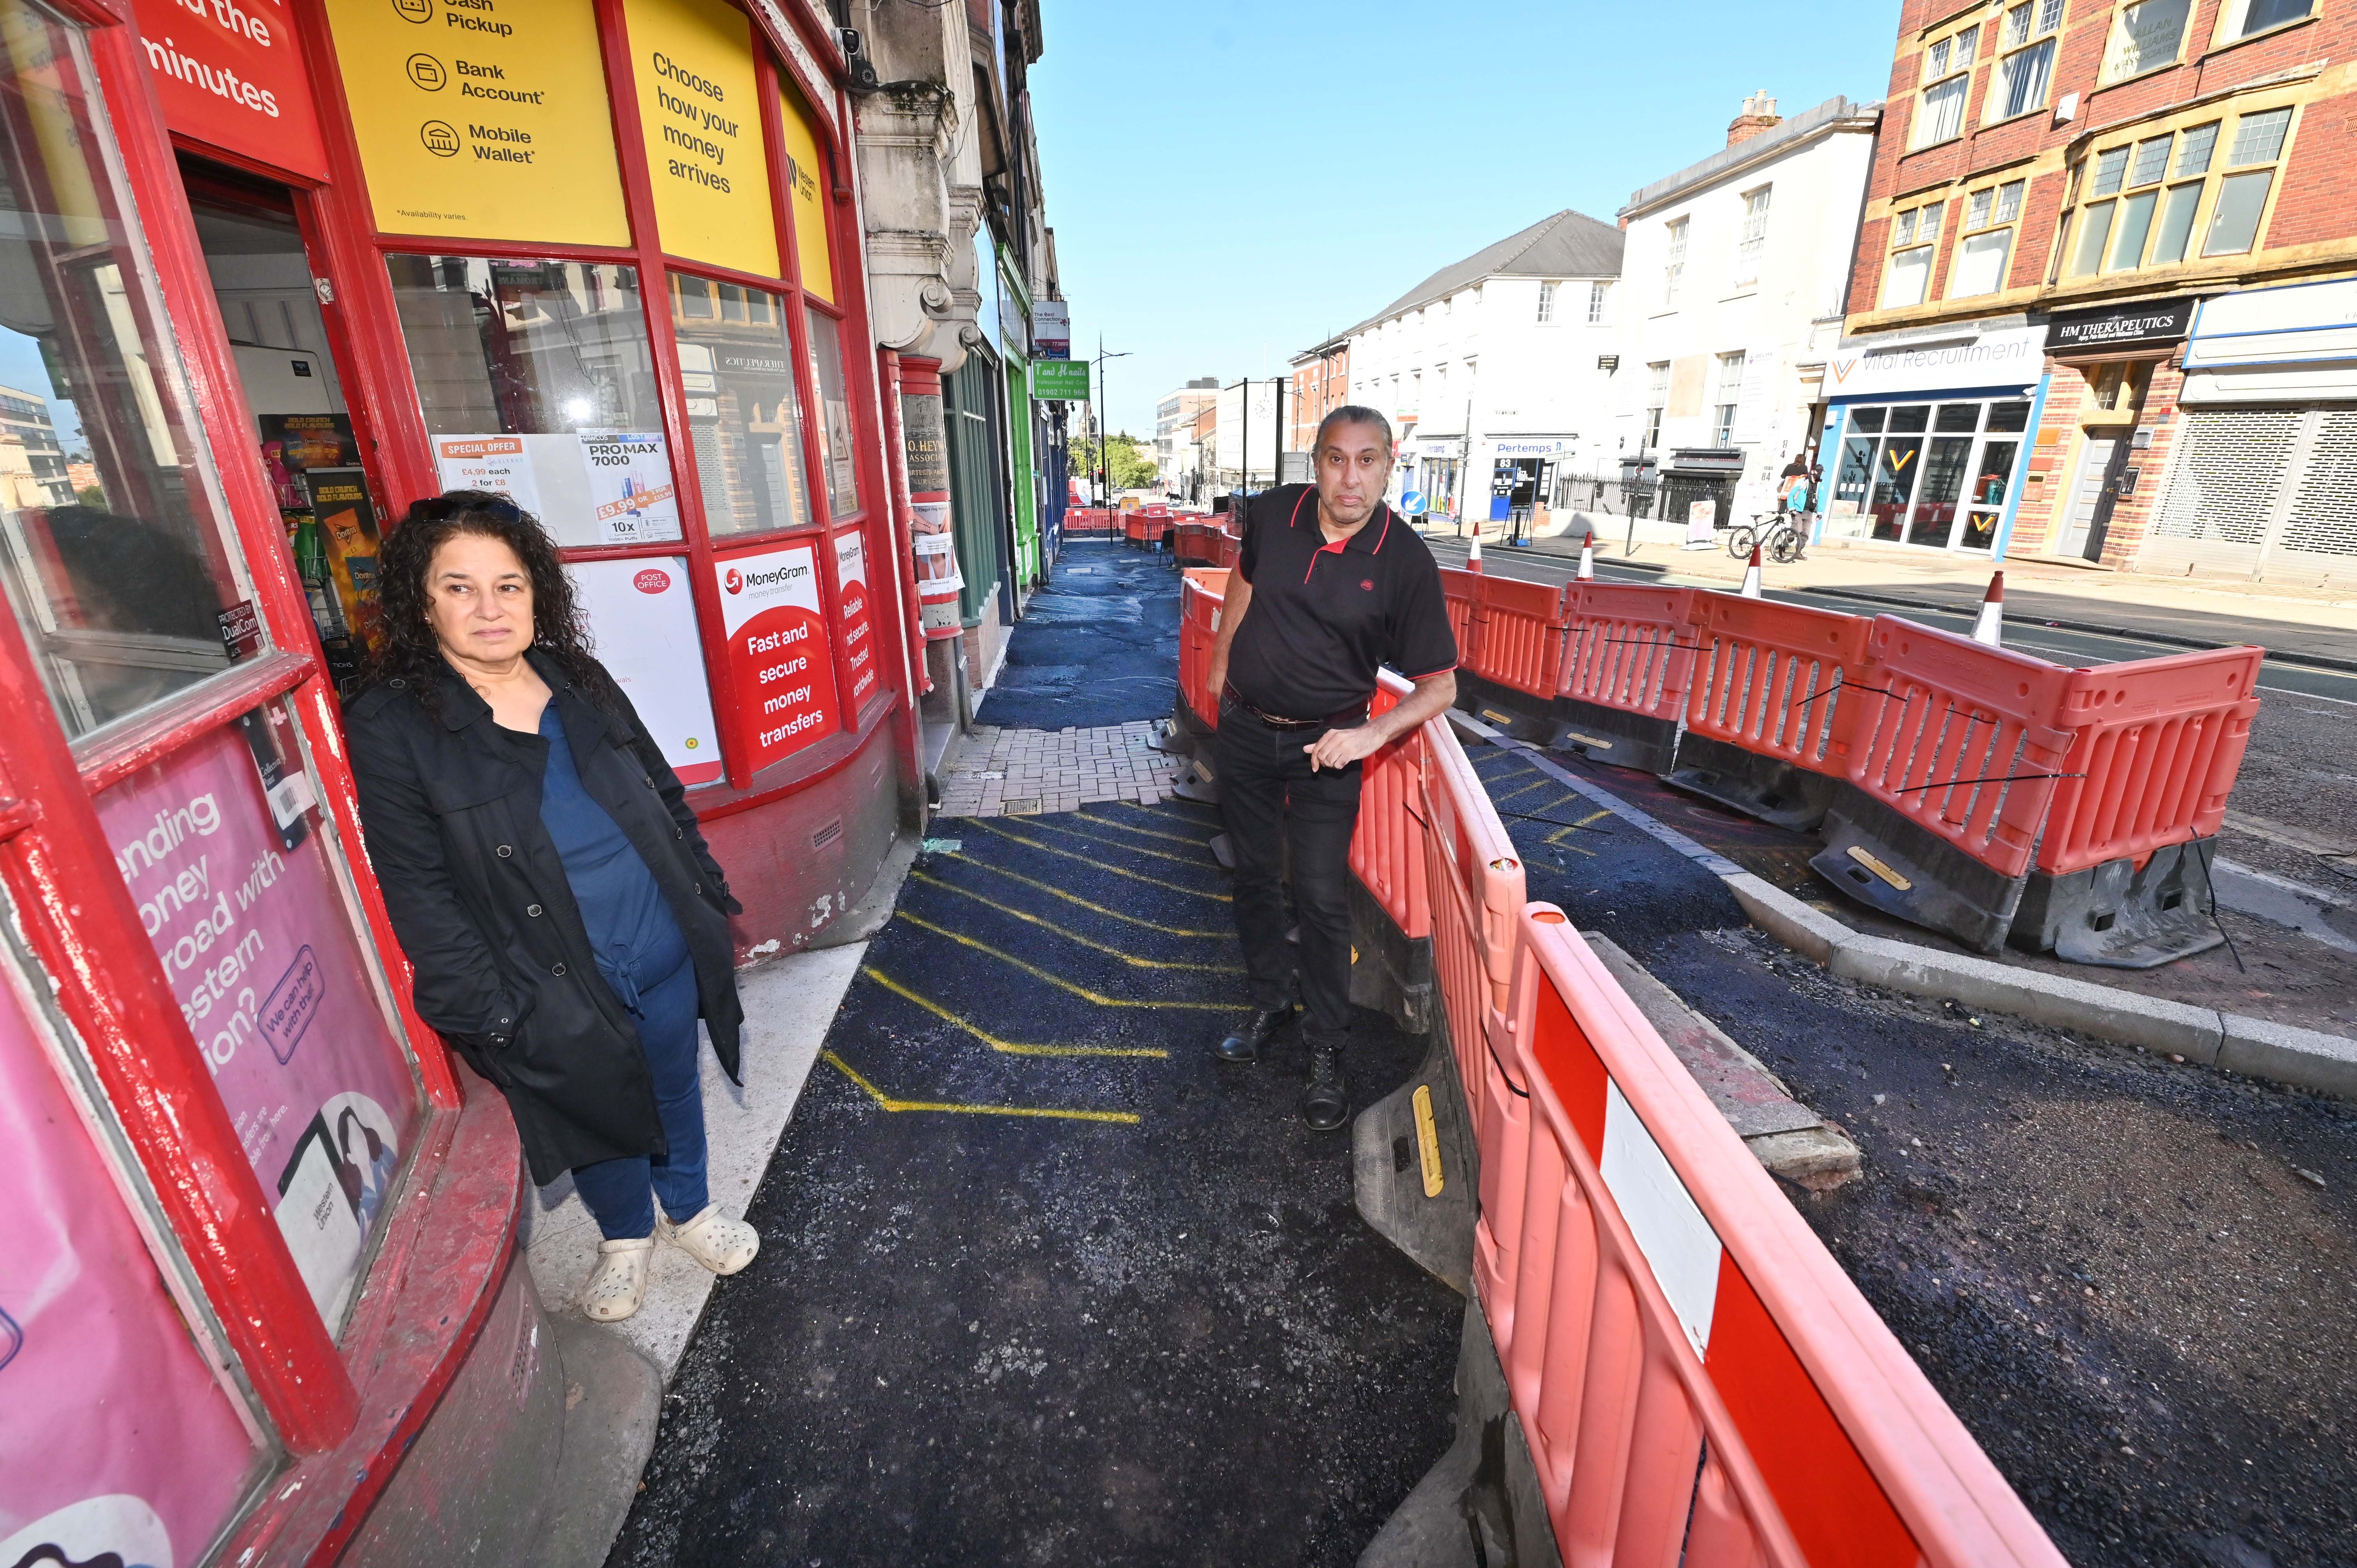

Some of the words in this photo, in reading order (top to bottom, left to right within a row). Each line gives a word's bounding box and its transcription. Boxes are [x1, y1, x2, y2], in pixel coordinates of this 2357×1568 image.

[210, 0, 270, 47] the
[447, 12, 513, 37] Pickup
[456, 60, 505, 80] Bank
[652, 52, 724, 102] Choose
[657, 85, 697, 121] how
[700, 109, 738, 138] your
[469, 124, 532, 144] Mobile
[664, 124, 724, 166] money
[669, 159, 731, 194] arrives
[797, 162, 816, 193] Western
[799, 180, 813, 204] Union
[2060, 326, 2080, 337] HM
[2082, 316, 2174, 335] THERAPEUTICS
[1864, 351, 1899, 371] Vital
[1904, 337, 2029, 368] Recruitment
[1035, 363, 1042, 376] T
[1042, 367, 1055, 376] and
[1058, 364, 1067, 377] H
[1069, 367, 1086, 376] nails
[448, 444, 485, 454] SPECIAL
[488, 442, 515, 452] OFFER
[589, 445, 621, 455] PRO
[623, 443, 658, 454] MAX
[1498, 444, 1551, 453] Pertemps
[592, 455, 630, 466] 7000
[1500, 459, 1511, 468] 83
[1762, 473, 1770, 481] 84
[598, 498, 636, 519] £9.99
[654, 491, 672, 501] £15.99
[336, 526, 357, 540] Doritos
[839, 546, 859, 563] MoneyGram
[638, 579, 666, 588] OFFICE
[746, 566, 807, 587] MoneyGram
[749, 590, 769, 600] money
[770, 583, 793, 595] transfer
[218, 607, 246, 625] PROTECTED
[245, 604, 252, 614] BY
[843, 595, 862, 620] Reliable
[222, 618, 257, 640] DualCom
[747, 632, 779, 655] Fast
[781, 621, 808, 645] and
[853, 621, 869, 641] secure.
[850, 643, 868, 671] Trusted
[759, 656, 807, 685] secure
[764, 685, 811, 715] money
[760, 709, 823, 748] transfers
[260, 758, 281, 777] Collection
[235, 849, 285, 912] with
[267, 1006, 288, 1033] We
[281, 983, 301, 1019] can
[296, 961, 314, 993] help
[282, 1010, 302, 1039] with
[300, 986, 316, 1014] that
[257, 1107, 267, 1123] are
[269, 1105, 288, 1127] here.
[313, 1182, 334, 1220] Western
[318, 1201, 334, 1231] Union
